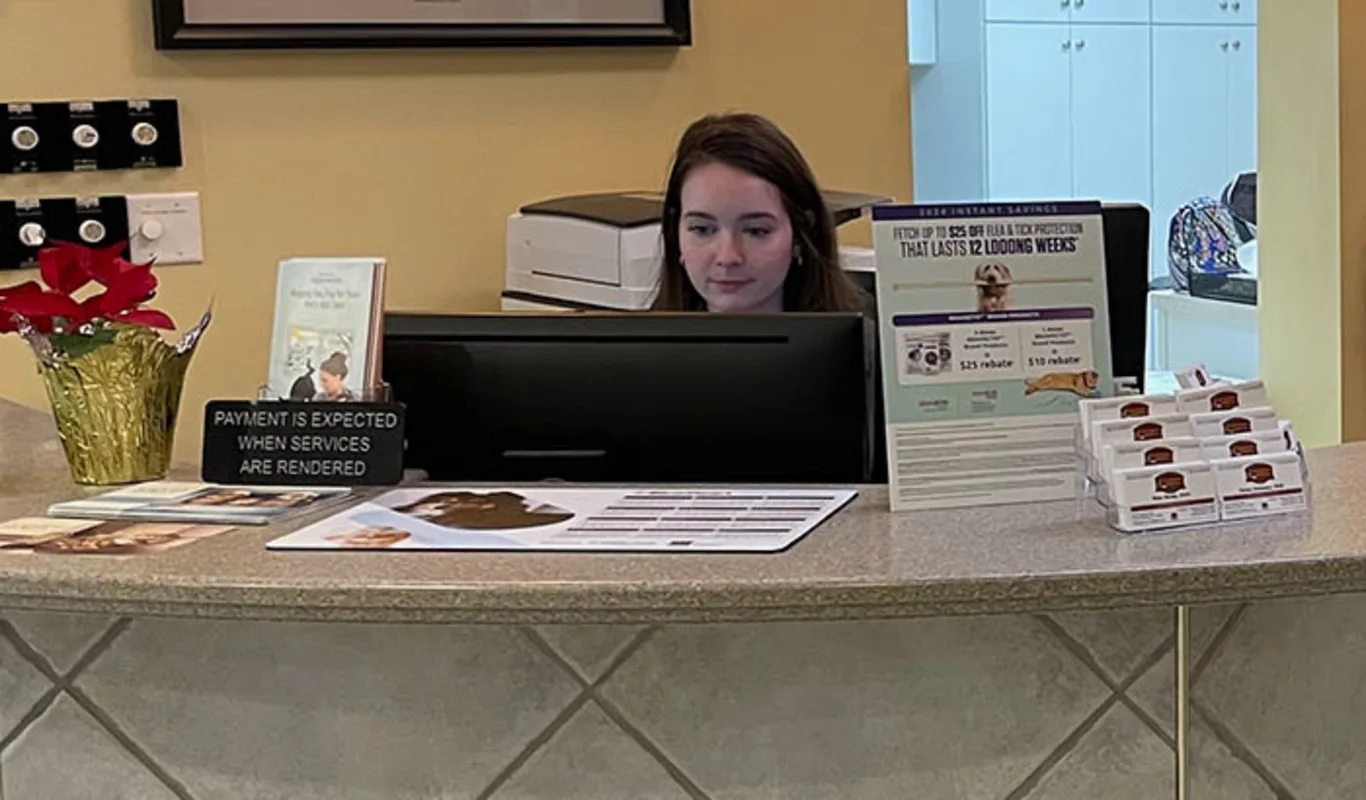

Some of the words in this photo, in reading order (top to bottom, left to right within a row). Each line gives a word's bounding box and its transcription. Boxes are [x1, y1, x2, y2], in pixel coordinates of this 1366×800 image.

[951, 206, 1002, 216] INSTANT
[1007, 204, 1058, 214] SAVINGS
[893, 226, 920, 240] FETCH
[922, 226, 934, 239] UP
[936, 225, 947, 239] TO
[949, 225, 966, 239] $25
[969, 224, 984, 237] OFF
[987, 223, 1005, 237] FLEA
[1015, 223, 1032, 236] TICK
[1034, 222, 1083, 236] PROTECTION
[901, 241, 928, 258] THAT
[931, 239, 967, 257] LASTS
[969, 239, 983, 255] 12
[984, 238, 1033, 255] LOOONG
[960, 361, 978, 371] $25
[1028, 358, 1046, 368] $10
[214, 411, 288, 427] PAYMENT
[293, 412, 307, 427] IS
[311, 412, 398, 429] EXPECTED
[238, 435, 287, 451] WHEN
[290, 436, 371, 452] SERVICES
[239, 459, 273, 475] ARE
[277, 460, 366, 476] RENDERED
